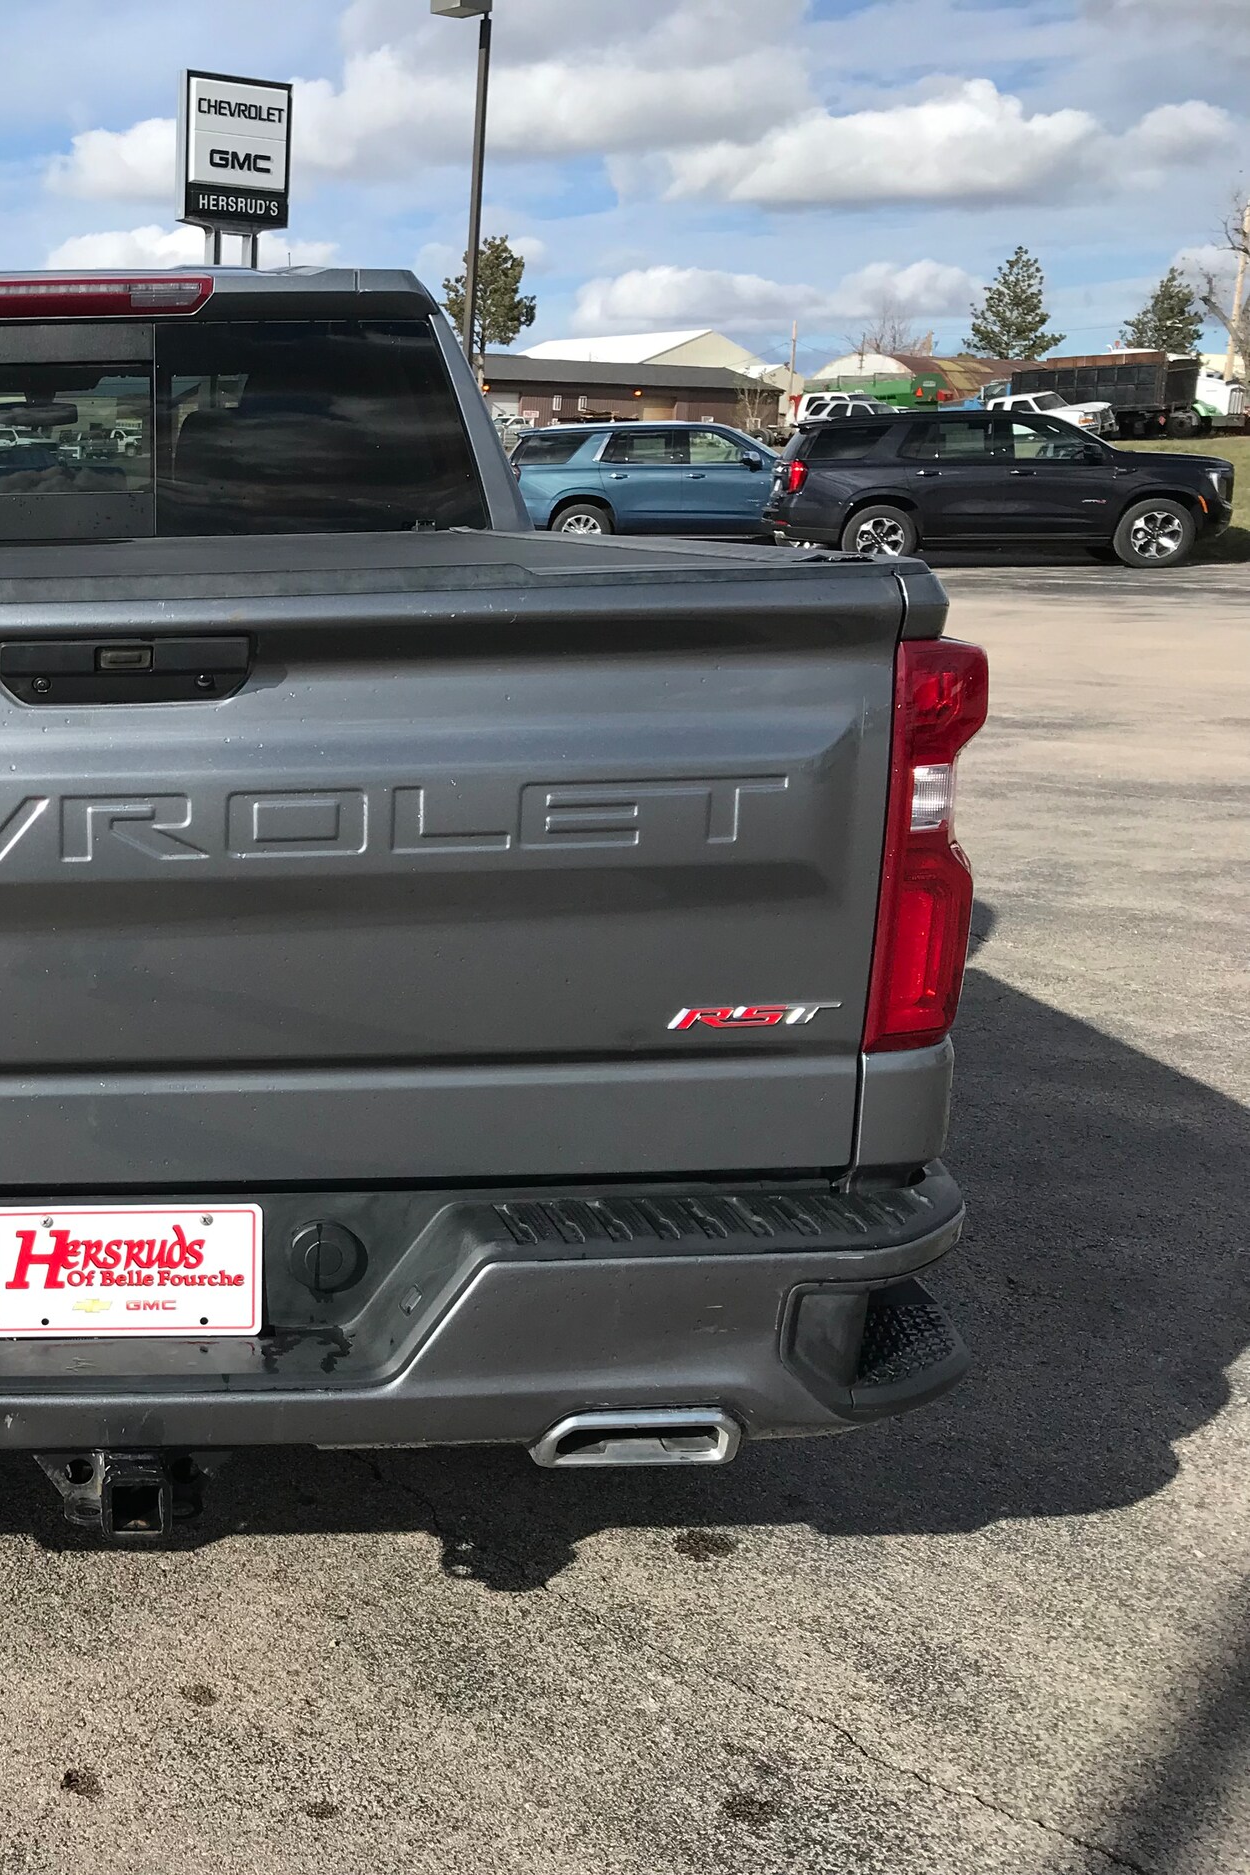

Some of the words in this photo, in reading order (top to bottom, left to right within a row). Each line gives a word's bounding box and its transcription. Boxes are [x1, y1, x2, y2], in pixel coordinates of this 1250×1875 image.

[198, 98, 285, 123] CHEVROLET
[209, 148, 272, 174] GMC
[199, 194, 279, 217] HERSRUD'S
[667, 1001, 843, 1030] RST
[67, 1270, 96, 1287] Of
[100, 1270, 154, 1287] Belle
[157, 1269, 245, 1287] Fourche
[125, 1299, 178, 1311] GMC
